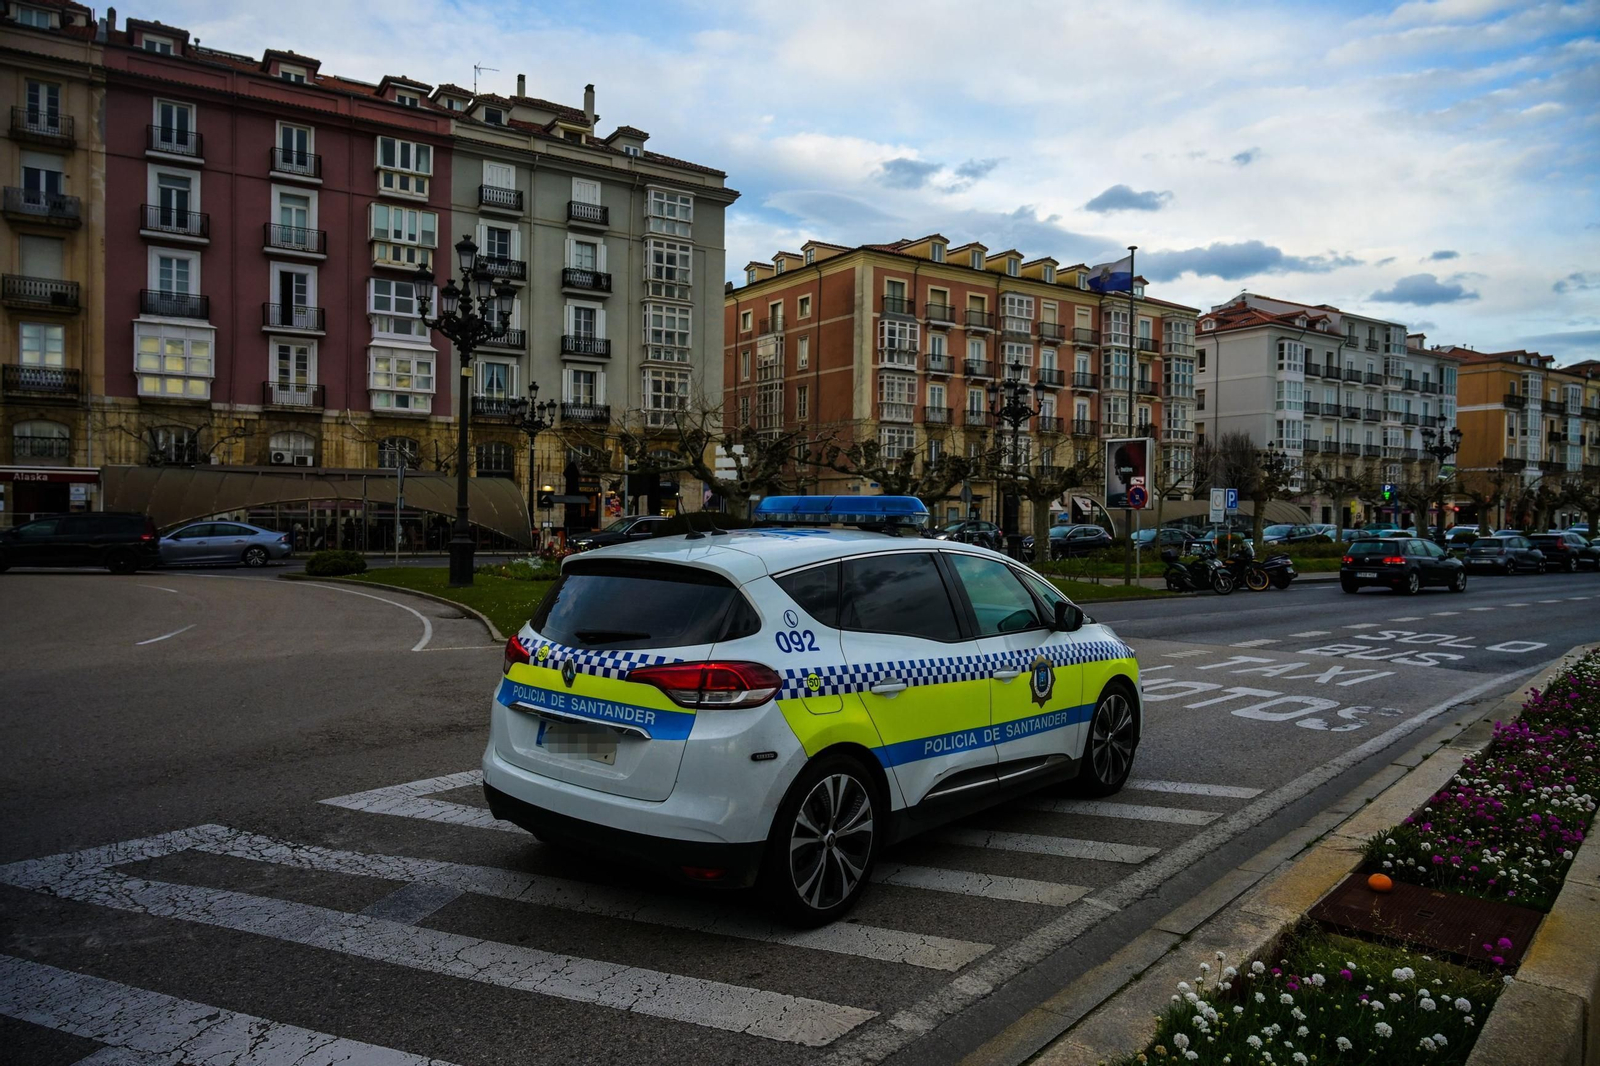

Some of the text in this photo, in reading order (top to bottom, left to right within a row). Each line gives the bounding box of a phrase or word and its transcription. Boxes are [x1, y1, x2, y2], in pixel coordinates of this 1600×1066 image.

[13, 473, 48, 481] Alaska
[1384, 484, 1391, 492] P
[1228, 491, 1236, 507] P
[538, 648, 547, 658] 50
[775, 629, 821, 654] 092
[1353, 629, 1548, 653] SOLO
[1297, 643, 1466, 667] BUS
[808, 677, 820, 688] 50
[1196, 655, 1397, 687] TAXI
[512, 684, 656, 726] POLICIA DE SANTANDER
[924, 712, 1068, 755] POLICIA DE SANTANDER
